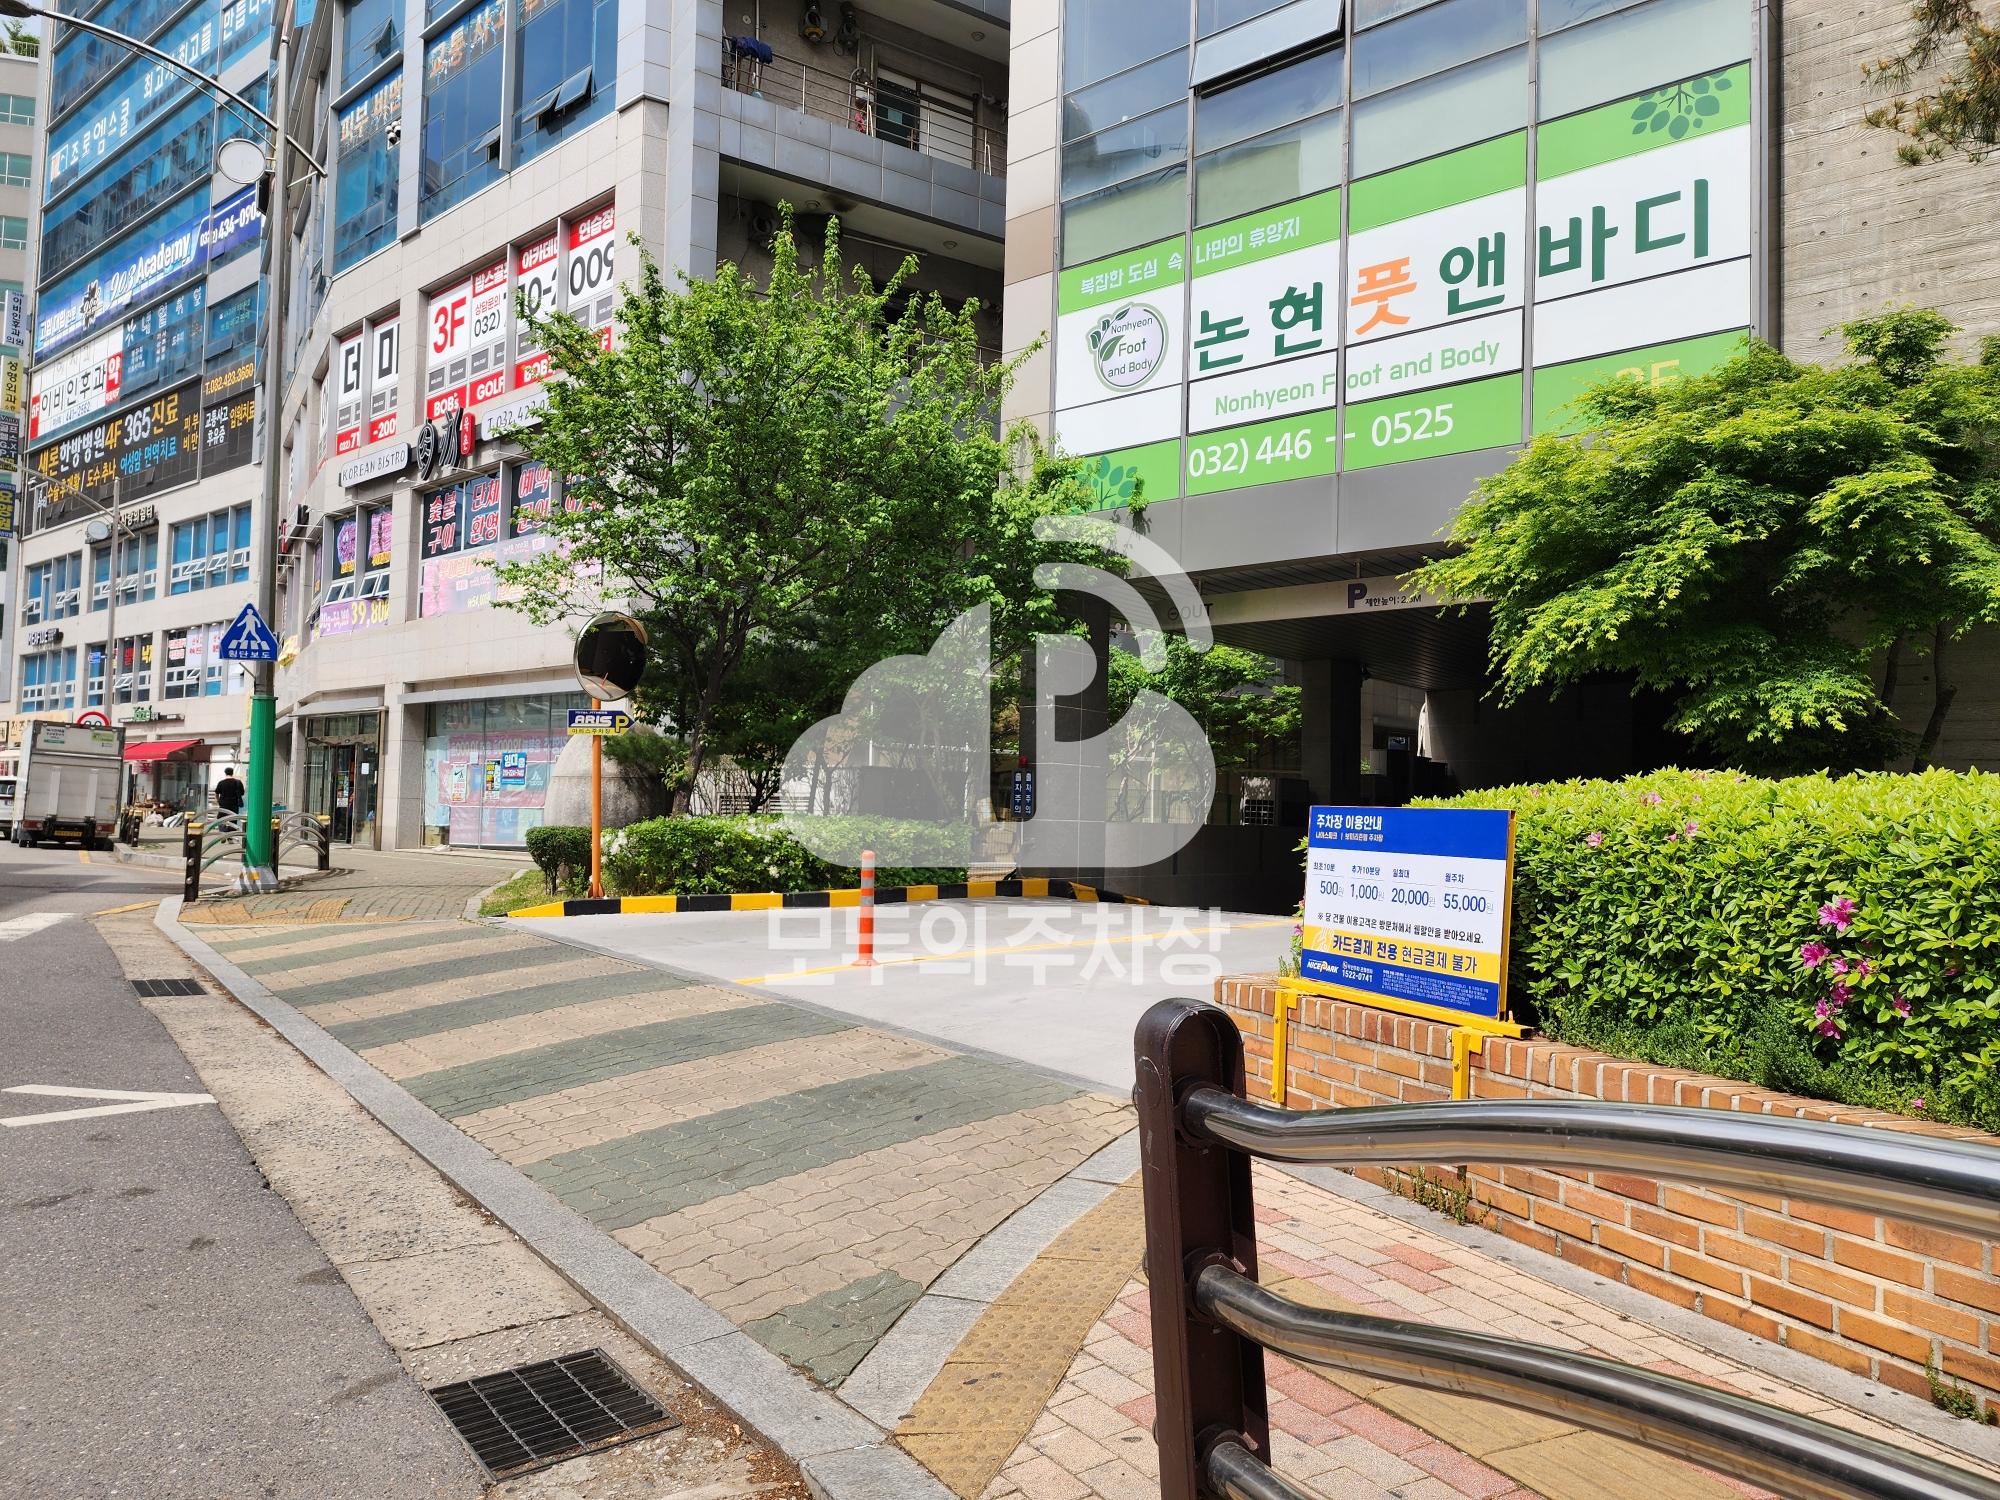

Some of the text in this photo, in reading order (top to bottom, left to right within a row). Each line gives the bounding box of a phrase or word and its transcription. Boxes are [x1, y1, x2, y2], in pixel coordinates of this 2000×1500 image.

[218, 201, 261, 240] 434-090
[136, 232, 192, 281] Academy
[1081, 216, 1301, 296] 복잡한 도심 속 나만의 휴양지
[432, 297, 467, 354] 3F
[1110, 315, 1154, 336] Nonhyeon
[1117, 338, 1148, 358] Foot
[1106, 356, 1154, 378] and Body
[1214, 379, 1316, 416] Nonhyeon
[1389, 351, 1433, 383] and
[1439, 338, 1500, 373] Body
[41, 362, 106, 416] 이비인후과
[59, 424, 106, 473] 한방병원
[104, 420, 123, 450] 4F
[123, 407, 151, 446] 365
[151, 392, 179, 435] 진료
[183, 411, 199, 433] 피부
[204, 405, 229, 428] 교통사고
[144, 435, 177, 468] 면역치료
[1188, 437, 1250, 479] 032)
[1254, 428, 1312, 462] 446
[1370, 403, 1454, 447] 0525
[341, 450, 406, 481] KOREAN BISTRO
[427, 490, 457, 524] 숯불
[471, 478, 500, 512] 단체
[469, 511, 500, 544] 환영
[1346, 582, 1368, 609] P
[228, 649, 271, 659] 횡단보도
[572, 714, 630, 734] ARIS P
[1316, 813, 1383, 831] 주차장 이용안내
[1313, 861, 1465, 884] 최초10분 추가10분당 일최대 월주차
[1325, 912, 1484, 944] 당 건물 이용고객은 방문처에서 웹할인을 받아오세요.
[1332, 934, 1478, 975] 카드결제 전용 현금결제 불가
[1341, 969, 1373, 983] 1522-0741
